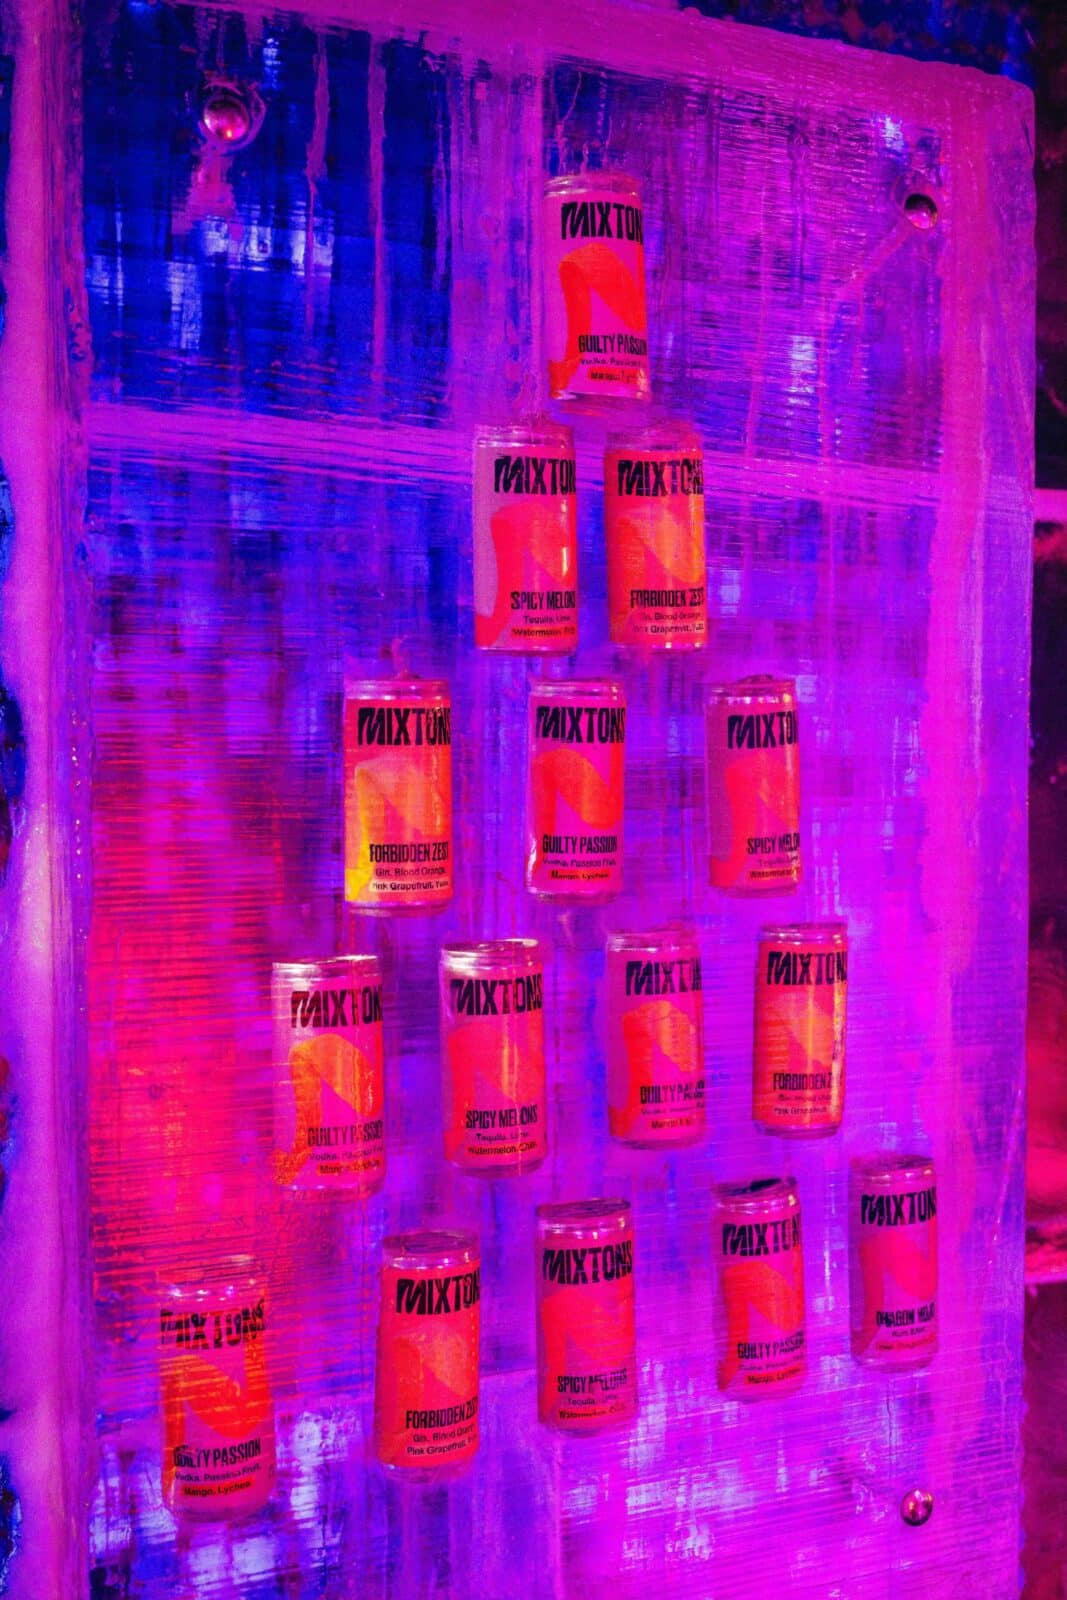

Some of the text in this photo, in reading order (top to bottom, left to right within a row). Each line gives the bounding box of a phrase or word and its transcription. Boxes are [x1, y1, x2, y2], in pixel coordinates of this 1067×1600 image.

[578, 335, 615, 353] GUILTY
[510, 591, 544, 610] SPICY
[630, 589, 686, 608] FORBIDDEN
[369, 843, 430, 862] FORBIDDEN
[542, 834, 617, 853] GUILTY PASSION
[747, 838, 776, 854] SPICY
[773, 1072, 826, 1092] FORBIDDEN
[466, 1109, 496, 1129] SPICY
[308, 1126, 348, 1146] GUILTY
[543, 1240, 632, 1285] MIXTONS
[737, 1343, 770, 1359] GUILTY
[557, 1375, 586, 1393] SPICY
[405, 1405, 464, 1429] FORBIDDEN
[212, 1438, 261, 1467] PASSION
